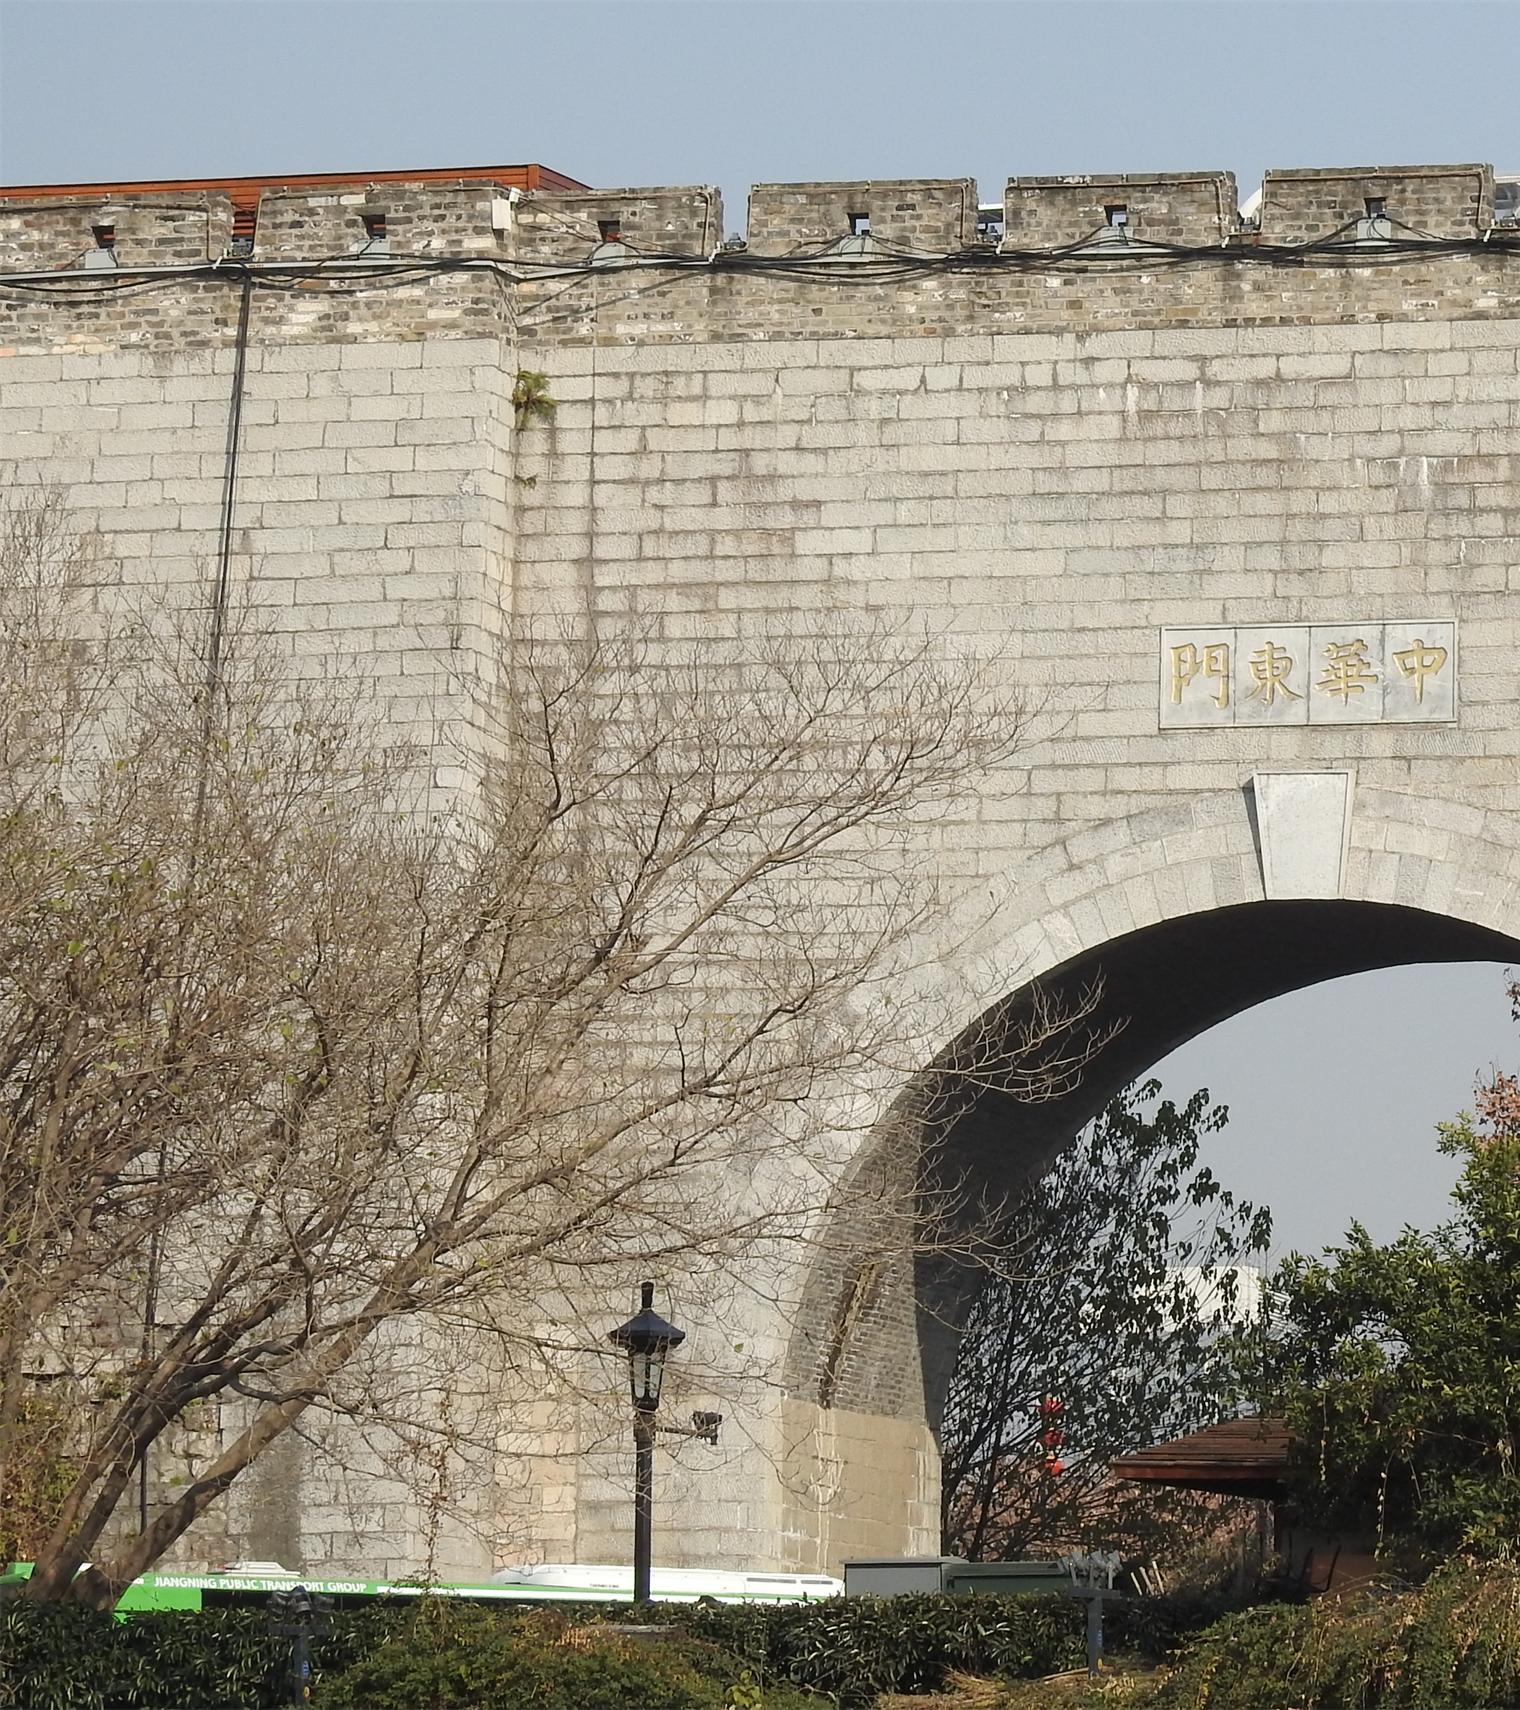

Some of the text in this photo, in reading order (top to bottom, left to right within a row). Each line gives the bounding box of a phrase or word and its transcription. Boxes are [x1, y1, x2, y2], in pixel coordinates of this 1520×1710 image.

[154, 1576, 217, 1589] JIANGNING
[218, 1578, 259, 1590] PUBLIC
[327, 1582, 367, 1594] GROUP
